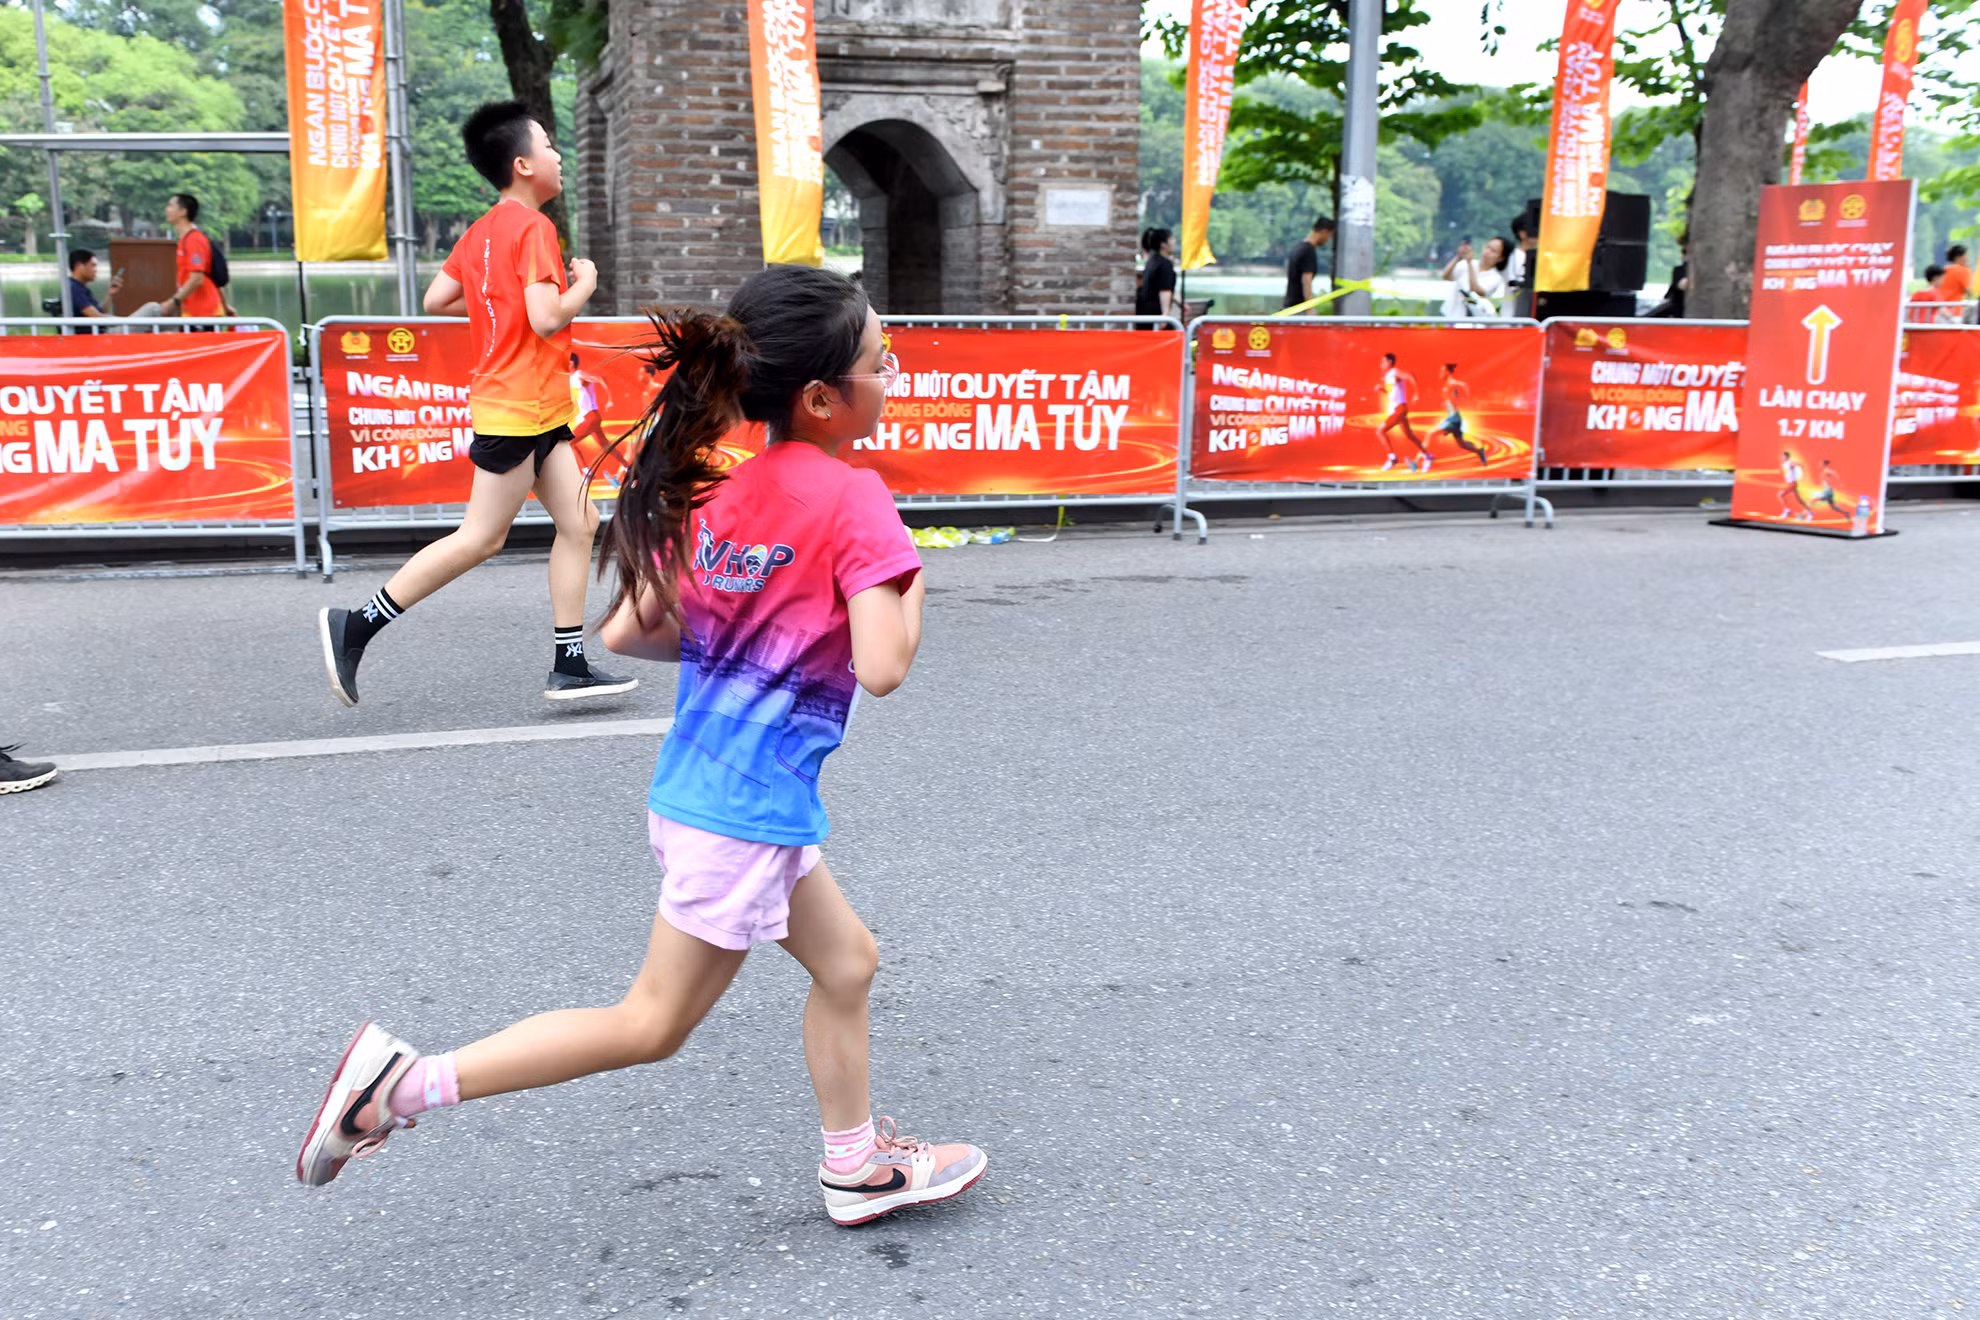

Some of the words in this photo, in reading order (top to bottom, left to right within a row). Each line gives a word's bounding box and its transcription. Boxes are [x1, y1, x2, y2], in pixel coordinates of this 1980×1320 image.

[346, 371, 431, 401] NGÀN
[913, 369, 951, 401] MỘT
[950, 369, 1056, 400] QUYẾT
[1060, 369, 1130, 401] TÂM
[1212, 363, 1278, 391] NGÀN
[0, 379, 128, 415] QUYẾT
[133, 377, 224, 413] TÂM
[923, 399, 972, 418] ĐỒNG
[1684, 390, 1739, 432] MA
[1759, 384, 1803, 408] LÀN
[1806, 389, 1867, 415] CHẠY
[348, 407, 393, 425] CHUNG
[975, 403, 1041, 451] MA
[1047, 398, 1129, 451] TÚY
[1289, 415, 1317, 441] MA
[1777, 418, 1807, 437] 1.7
[1809, 420, 1844, 439] KM
[34, 419, 120, 474] MA
[122, 411, 224, 473] TÚY
[350, 427, 371, 443] VÌ
